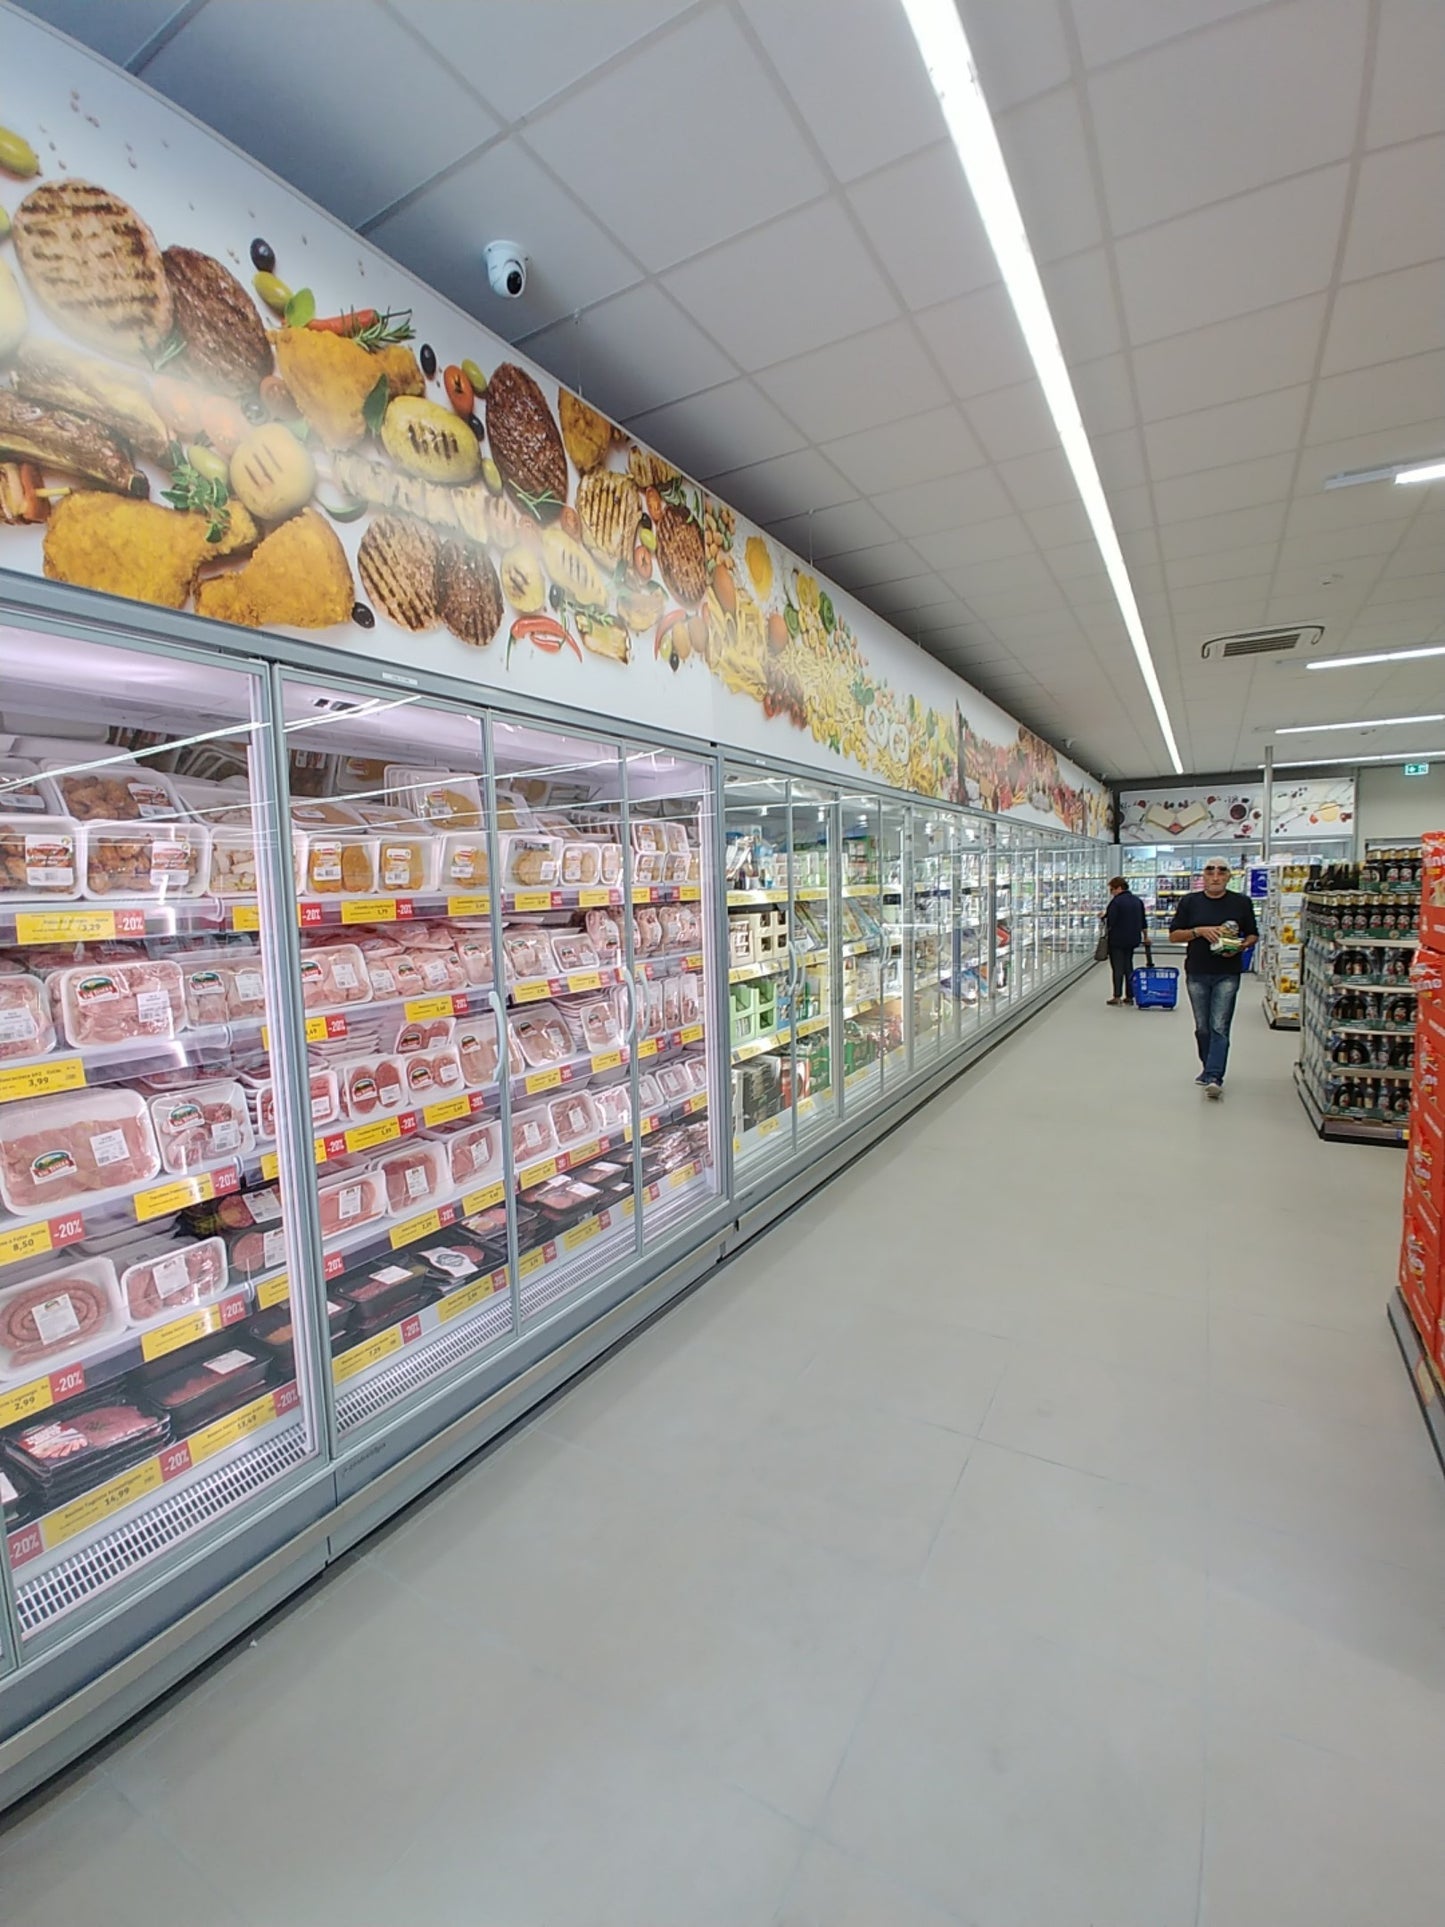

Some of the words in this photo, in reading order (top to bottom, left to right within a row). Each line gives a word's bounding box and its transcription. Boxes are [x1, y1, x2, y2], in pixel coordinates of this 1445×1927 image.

[302, 908, 321, 921] -20%
[396, 904, 413, 915] -20%
[117, 916, 144, 931] -20%
[328, 1019, 346, 1033] -20%
[28, 1076, 50, 1088] 3,99
[327, 1139, 346, 1153] -20%
[214, 1171, 238, 1189] -20%
[53, 1218, 83, 1239] -20%
[12, 1238, 35, 1252] 8,50
[324, 1257, 343, 1273] -20%
[222, 1300, 245, 1319] -20%
[54, 1371, 83, 1393] -20%
[276, 1389, 298, 1409] -20%
[163, 1450, 190, 1473] -20%
